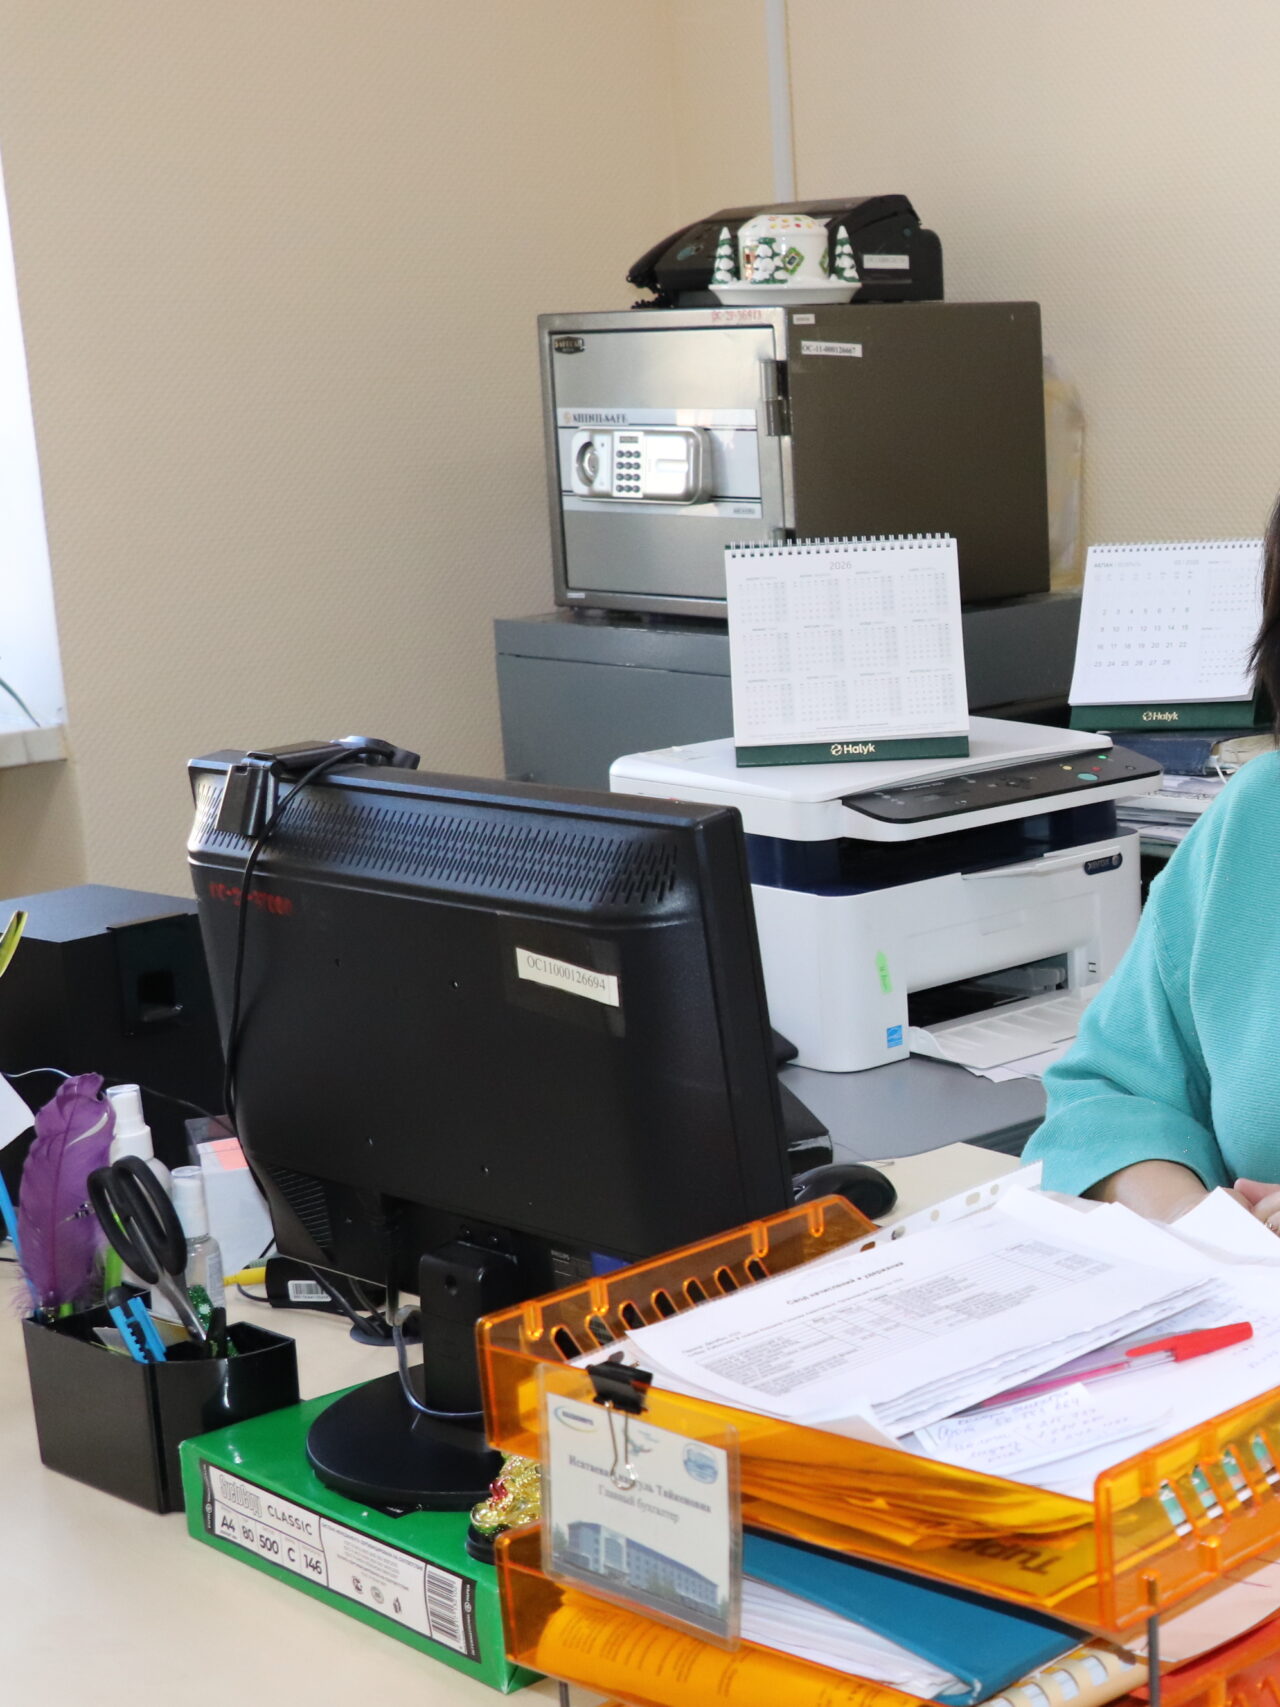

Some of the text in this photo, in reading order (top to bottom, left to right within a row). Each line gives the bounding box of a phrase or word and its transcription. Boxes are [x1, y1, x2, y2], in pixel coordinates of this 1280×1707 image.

[829, 561, 853, 571] 2026
[1153, 711, 1179, 722] Halyk
[843, 743, 876, 755] Halyk
[267, 1505, 313, 1536] CLASSIC
[221, 1515, 323, 1575] A4 80 500 C 146
